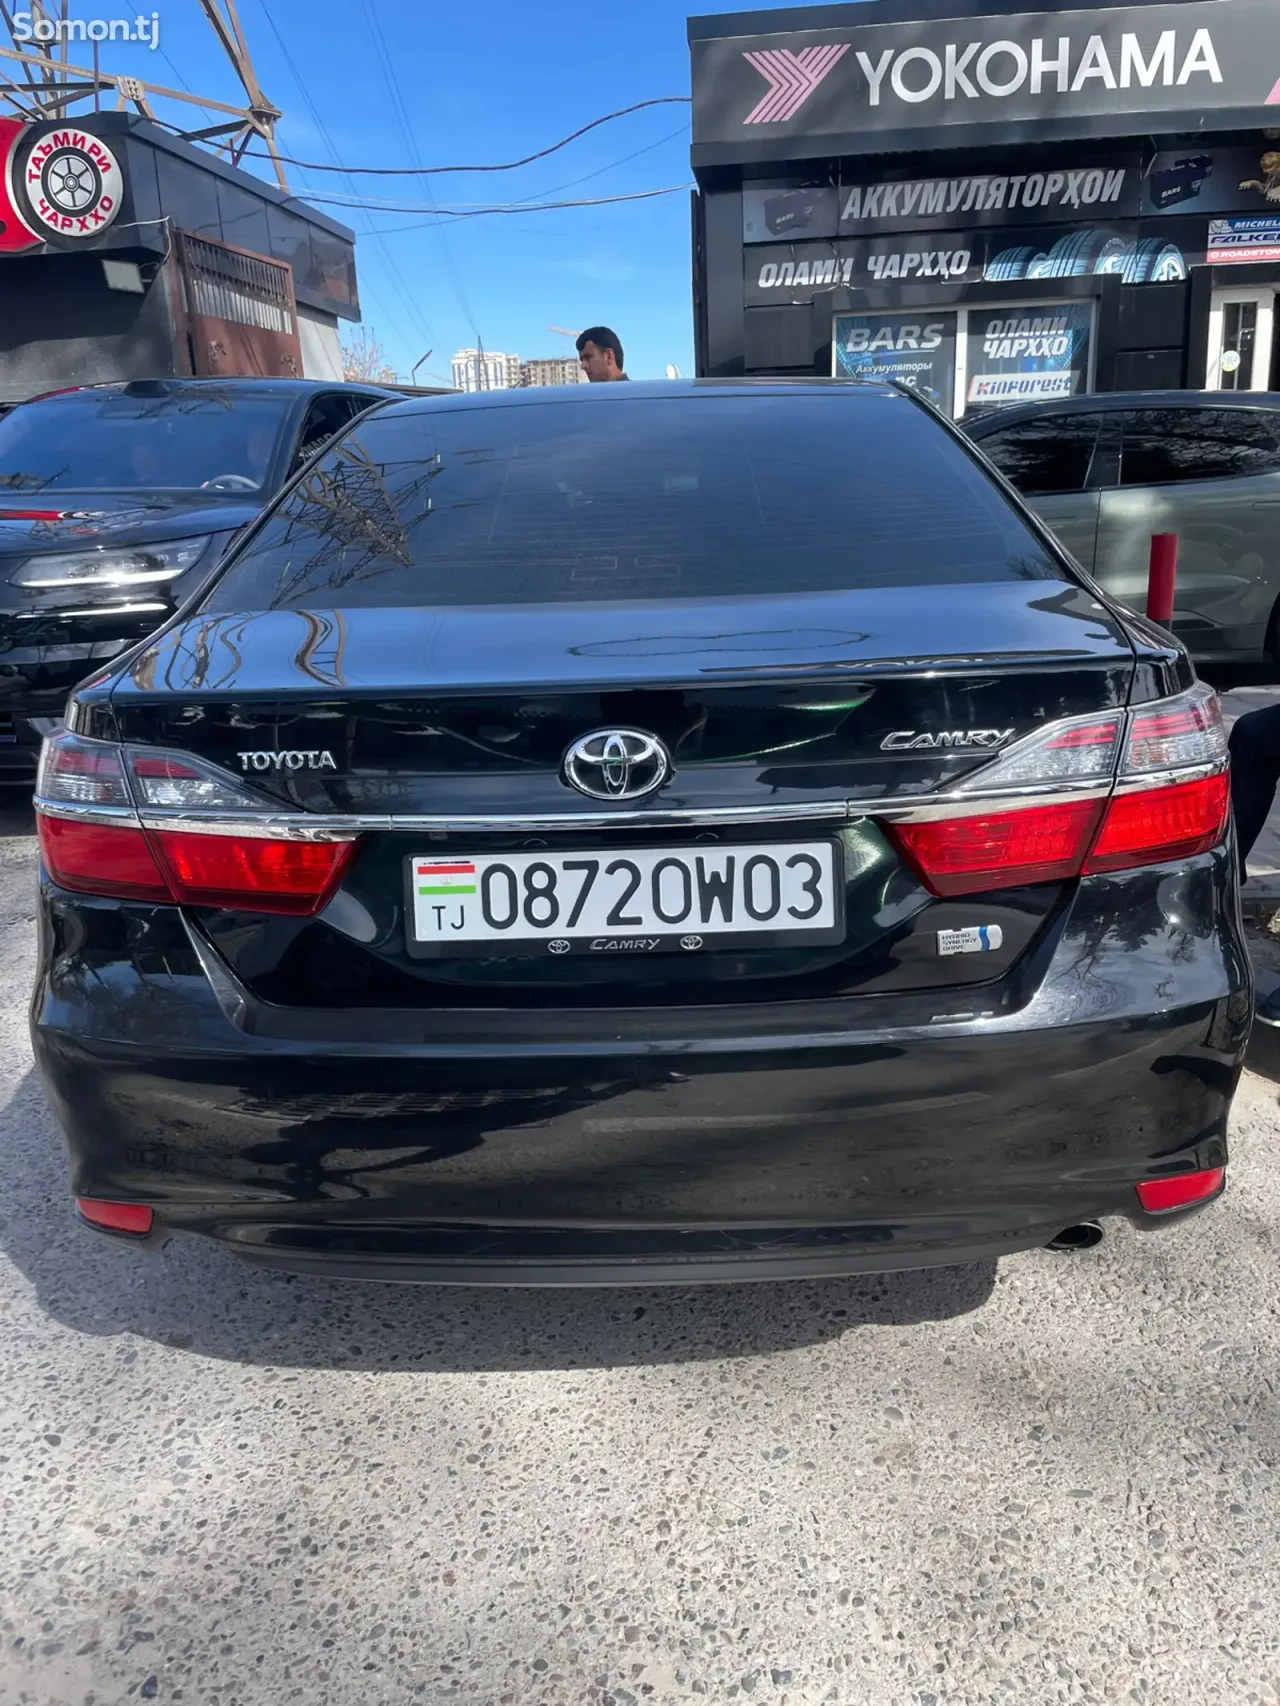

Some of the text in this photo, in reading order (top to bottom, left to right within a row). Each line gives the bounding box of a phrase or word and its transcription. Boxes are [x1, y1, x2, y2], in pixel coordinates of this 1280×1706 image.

[855, 28, 1224, 106] YOKOHAMA
[28, 131, 112, 184] ТАЪМИРИ
[1161, 186, 1181, 198] BARS
[1234, 219, 1280, 229] MICHEL
[758, 257, 854, 288] ОЛАМИ
[846, 323, 944, 353] BARS
[985, 316, 1068, 338] ОЛАМИ
[856, 362, 932, 374] Аккумуляторы
[880, 728, 1016, 750] CAMRY
[237, 750, 336, 770] TOYOTA
[431, 904, 465, 930] TJ
[589, 938, 661, 951] CAMRY
